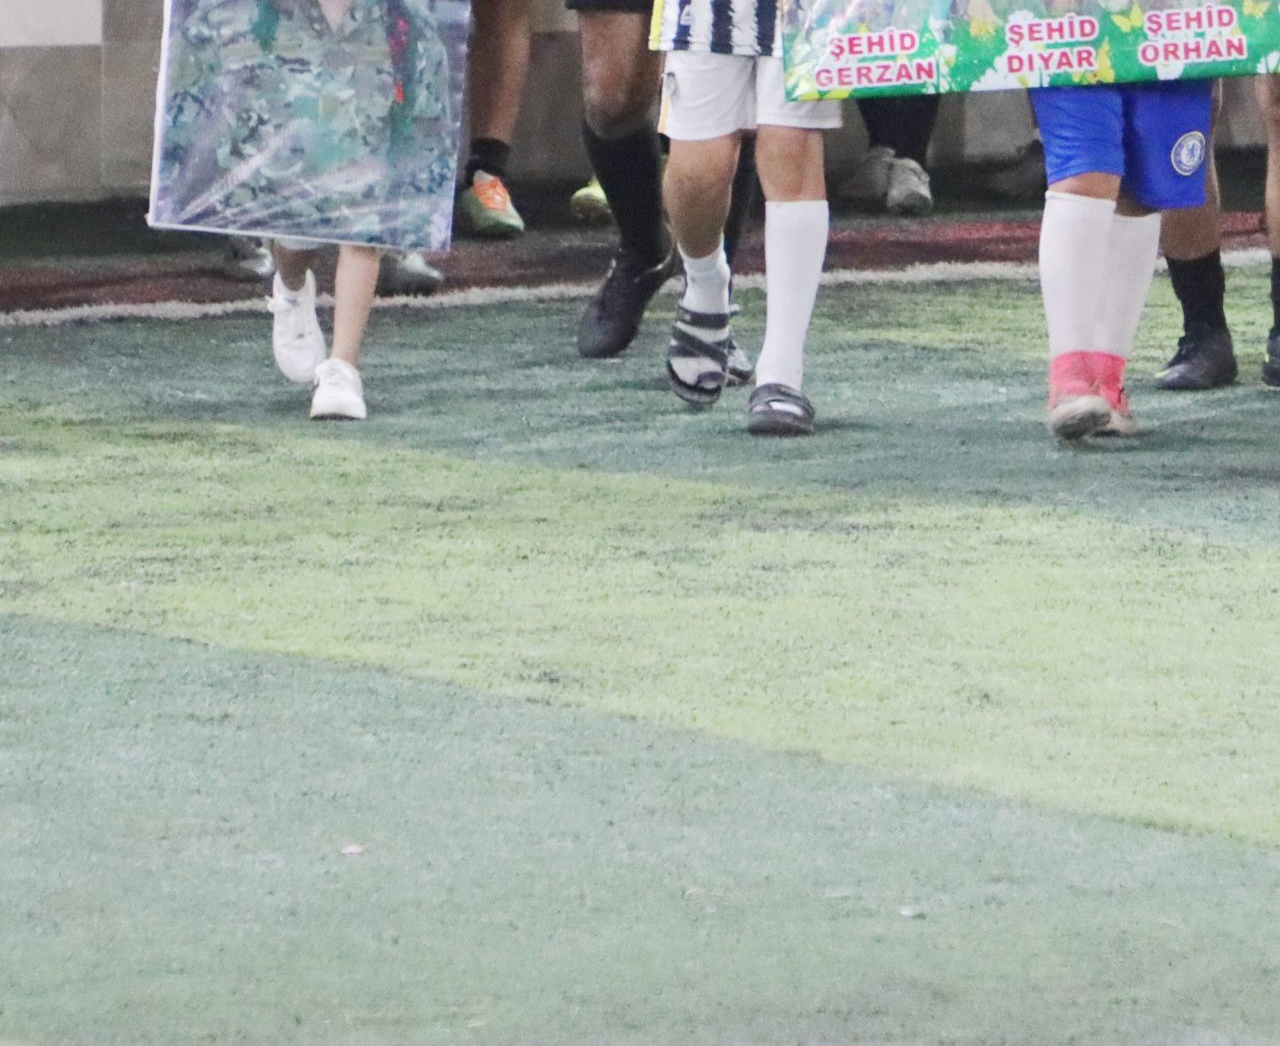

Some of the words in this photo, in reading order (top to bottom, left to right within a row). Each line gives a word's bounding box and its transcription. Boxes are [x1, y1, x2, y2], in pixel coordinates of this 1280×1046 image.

[1008, 16, 1098, 45] ŞEHÎD
[1146, 6, 1235, 36] ŞEHÎD
[829, 28, 917, 60] ŞEHÎD
[1140, 37, 1246, 63] ORHAN
[1008, 49, 1096, 73] DIYAR
[815, 62, 934, 88] GERZAN
